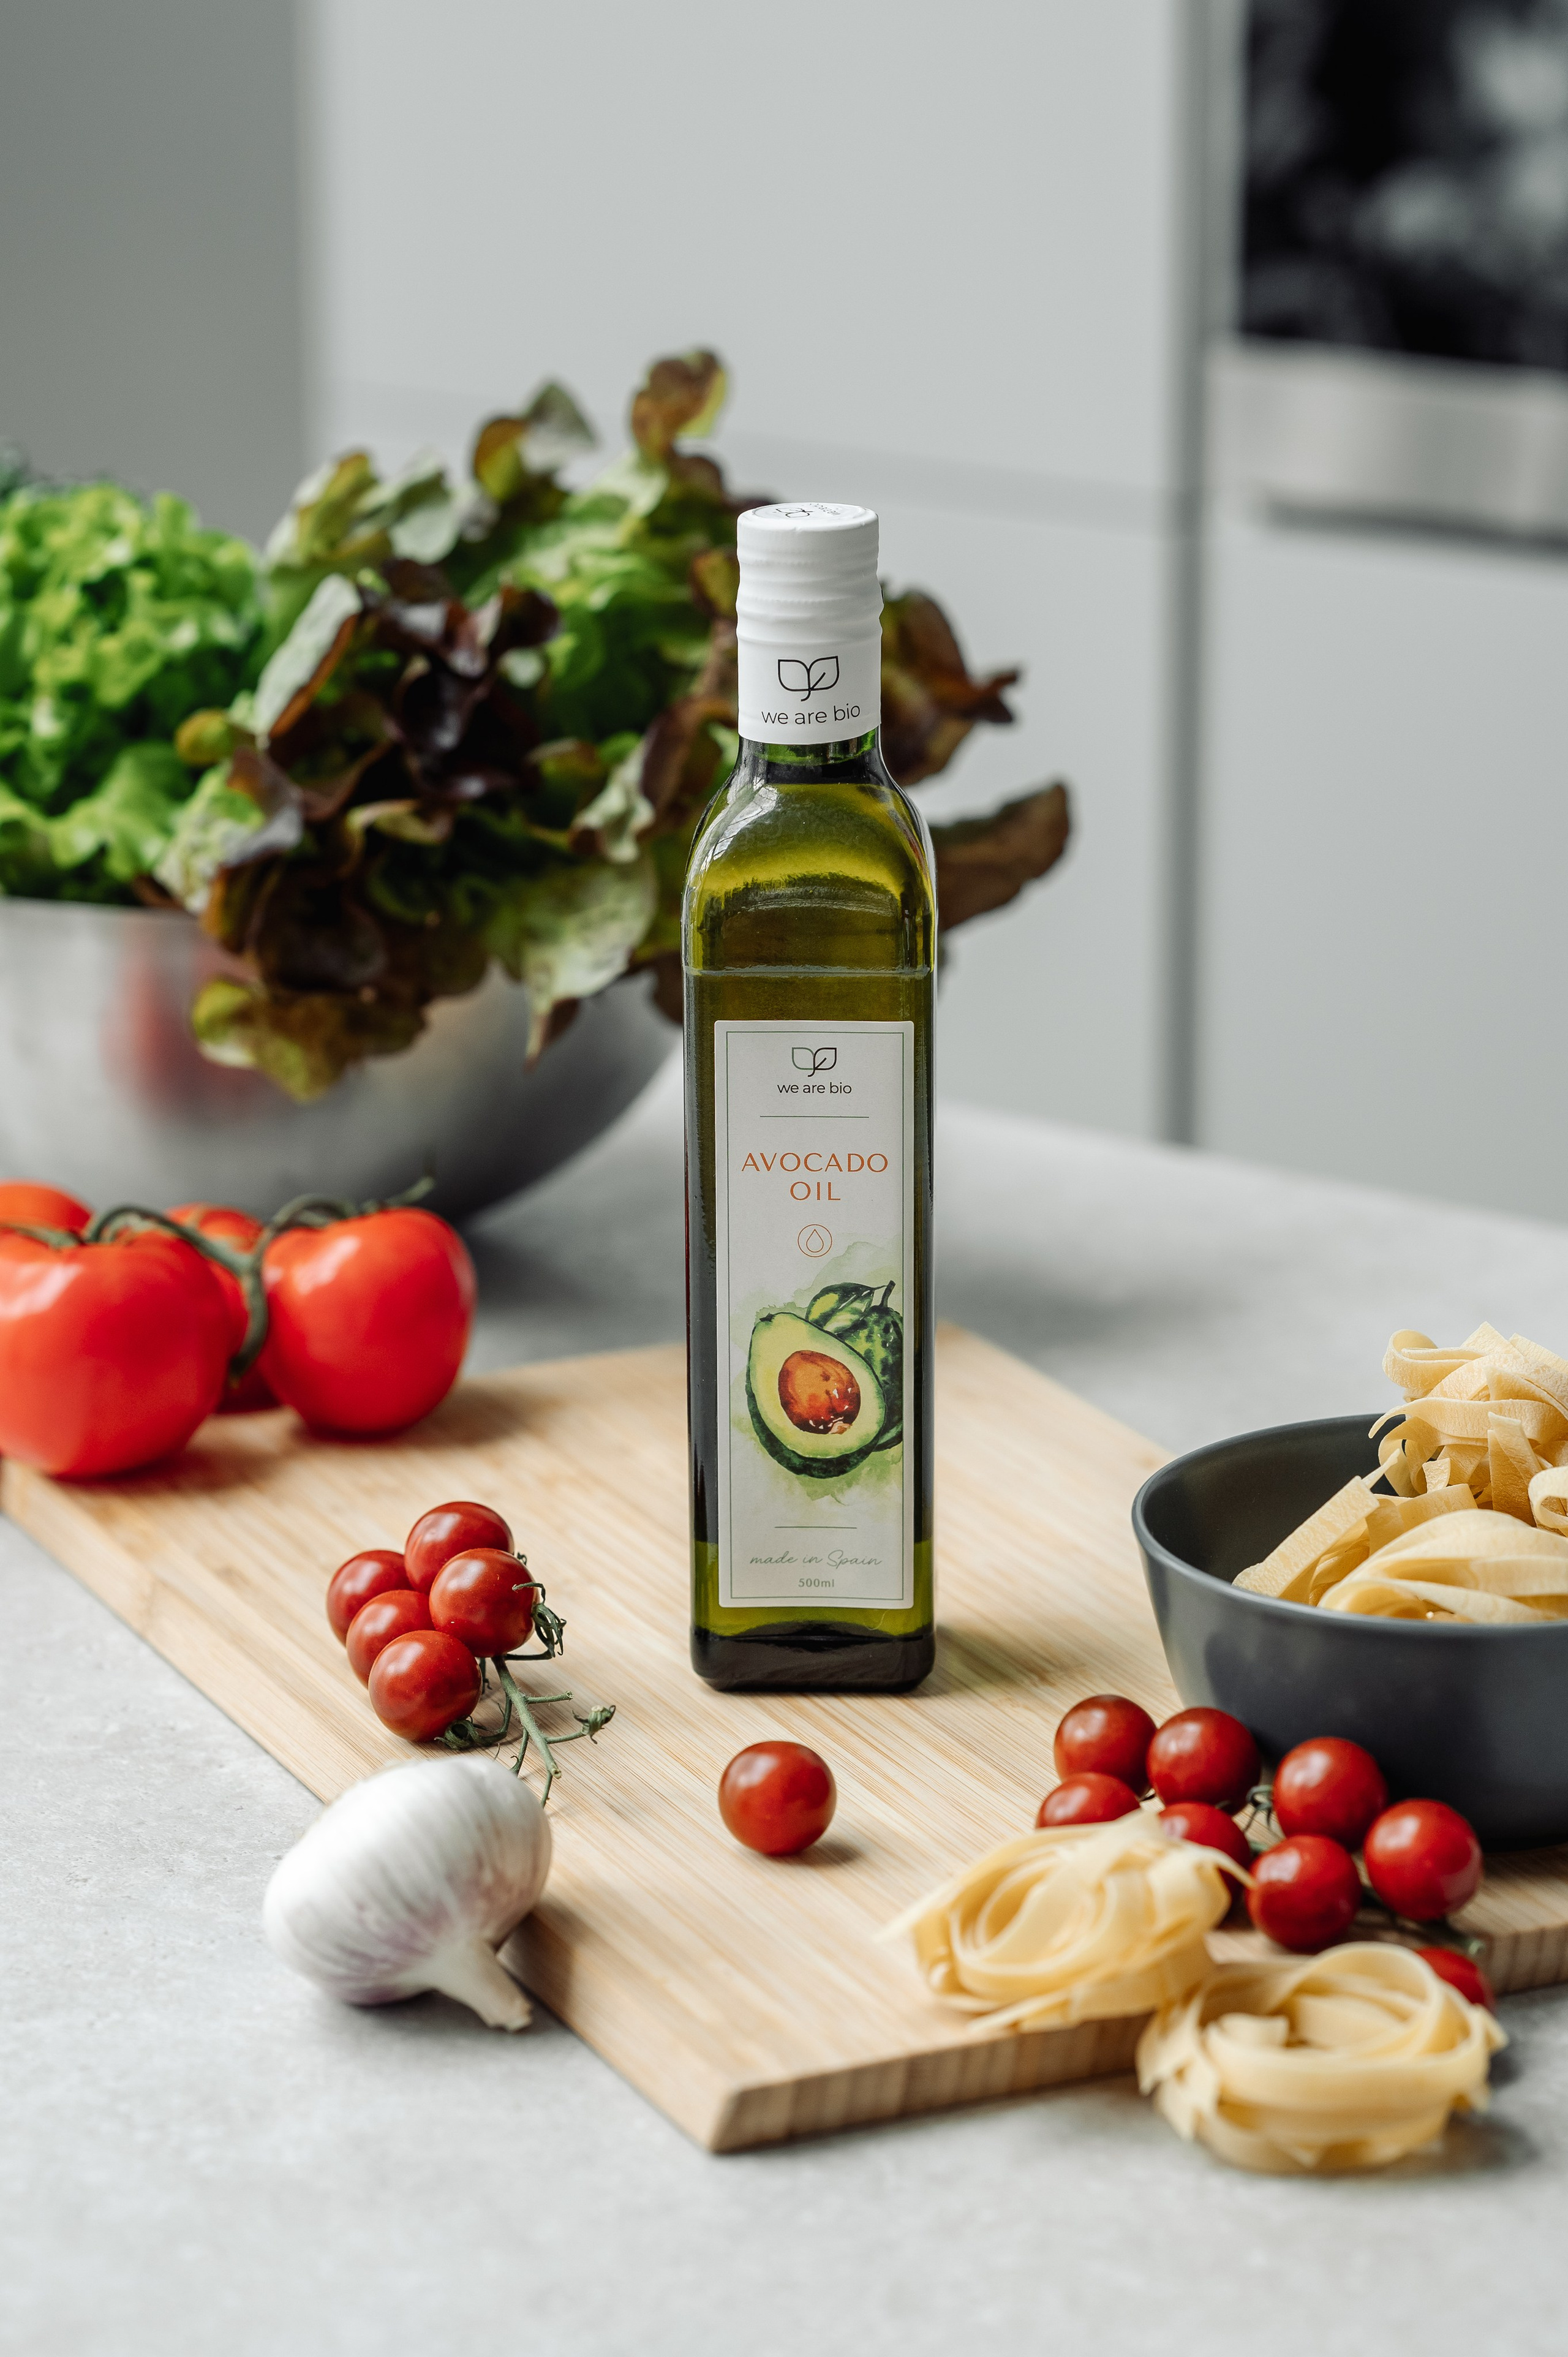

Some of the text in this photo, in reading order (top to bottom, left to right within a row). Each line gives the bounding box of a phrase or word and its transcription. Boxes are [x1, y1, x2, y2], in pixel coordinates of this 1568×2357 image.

[761, 703, 861, 725] we are bio
[777, 1082, 852, 1094] we are bio
[741, 1152, 888, 1173] AVOCADO
[790, 1181, 841, 1201] OIL
[750, 1549, 883, 1569] made in Spain
[798, 1578, 835, 1588] 500ml
